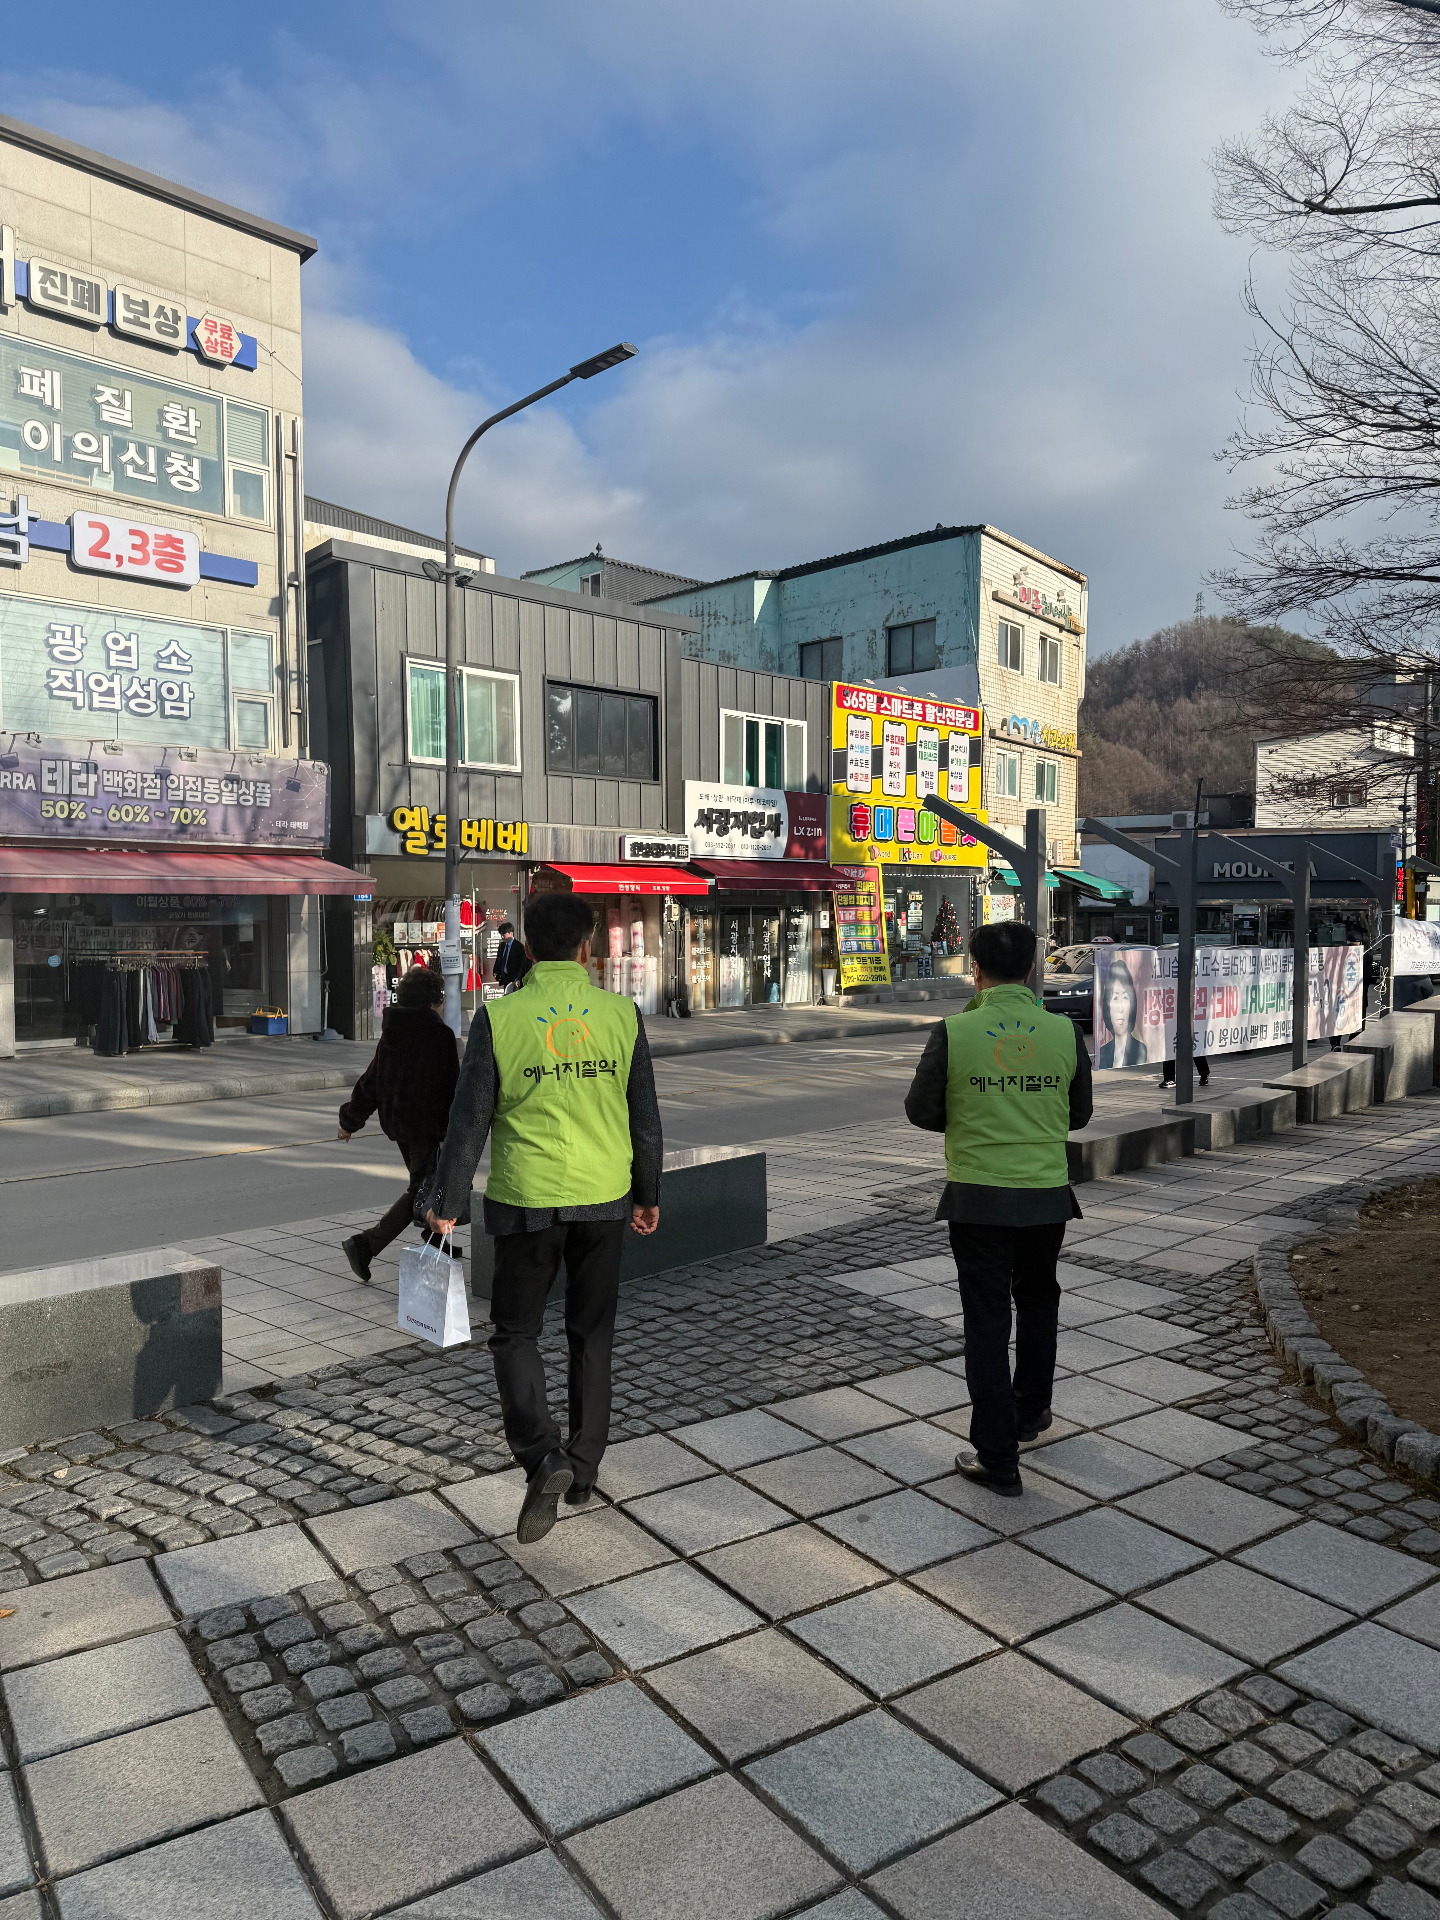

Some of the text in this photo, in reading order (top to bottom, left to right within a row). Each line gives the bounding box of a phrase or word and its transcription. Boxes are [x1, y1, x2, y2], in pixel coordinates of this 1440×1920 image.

[38, 266, 181, 339] 진폐 보상
[203, 318, 234, 342] 무료
[204, 336, 234, 359] 상담
[22, 419, 202, 493] 이의신청
[87, 520, 187, 574] 2,3층
[48, 668, 195, 718] 직업성암
[843, 690, 877, 713] 365일
[880, 701, 923, 720] 스마트폰
[889, 761, 901, 769] #SK
[889, 770, 901, 779] #KT
[41, 759, 98, 797] 테라
[102, 770, 161, 800] 백화점
[166, 774, 271, 807] 입점동일상품
[889, 781, 901, 790] #LG
[41, 800, 86, 820] 50%
[107, 806, 150, 823] 60%
[169, 807, 207, 826] 70%
[392, 804, 528, 855] 옐로베베
[793, 826, 804, 836] LX
[523, 1059, 617, 1084] 에너지절약
[970, 1075, 1061, 1093] 에너지절약
